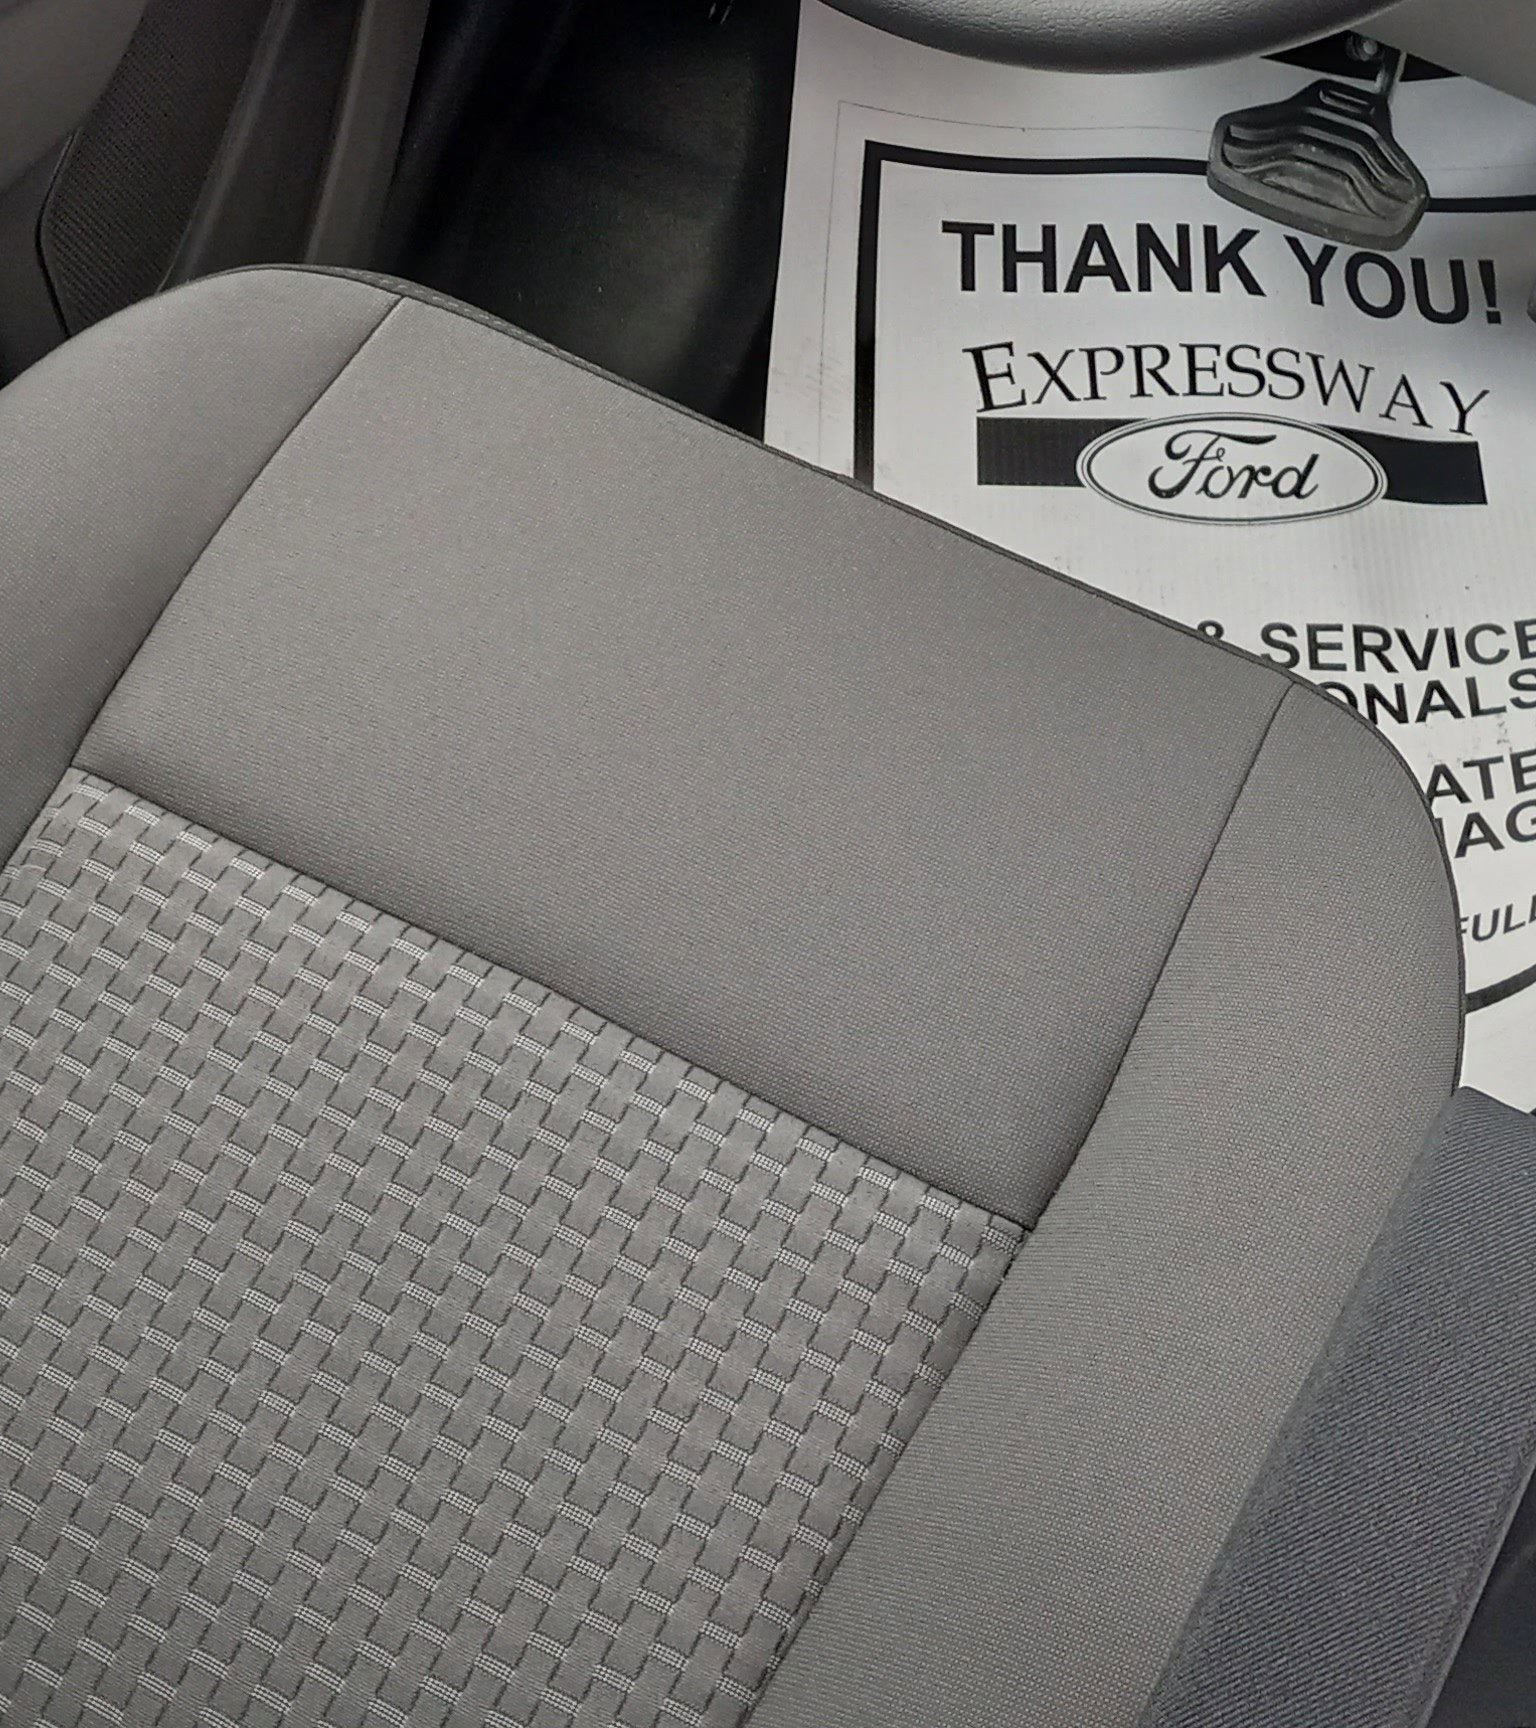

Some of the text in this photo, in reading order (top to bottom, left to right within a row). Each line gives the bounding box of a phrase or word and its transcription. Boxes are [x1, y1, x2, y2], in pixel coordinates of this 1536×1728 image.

[941, 220, 1503, 326] THANK YOU!
[960, 340, 1492, 438] EXPRESSWAY
[1146, 428, 1322, 505] Ford
